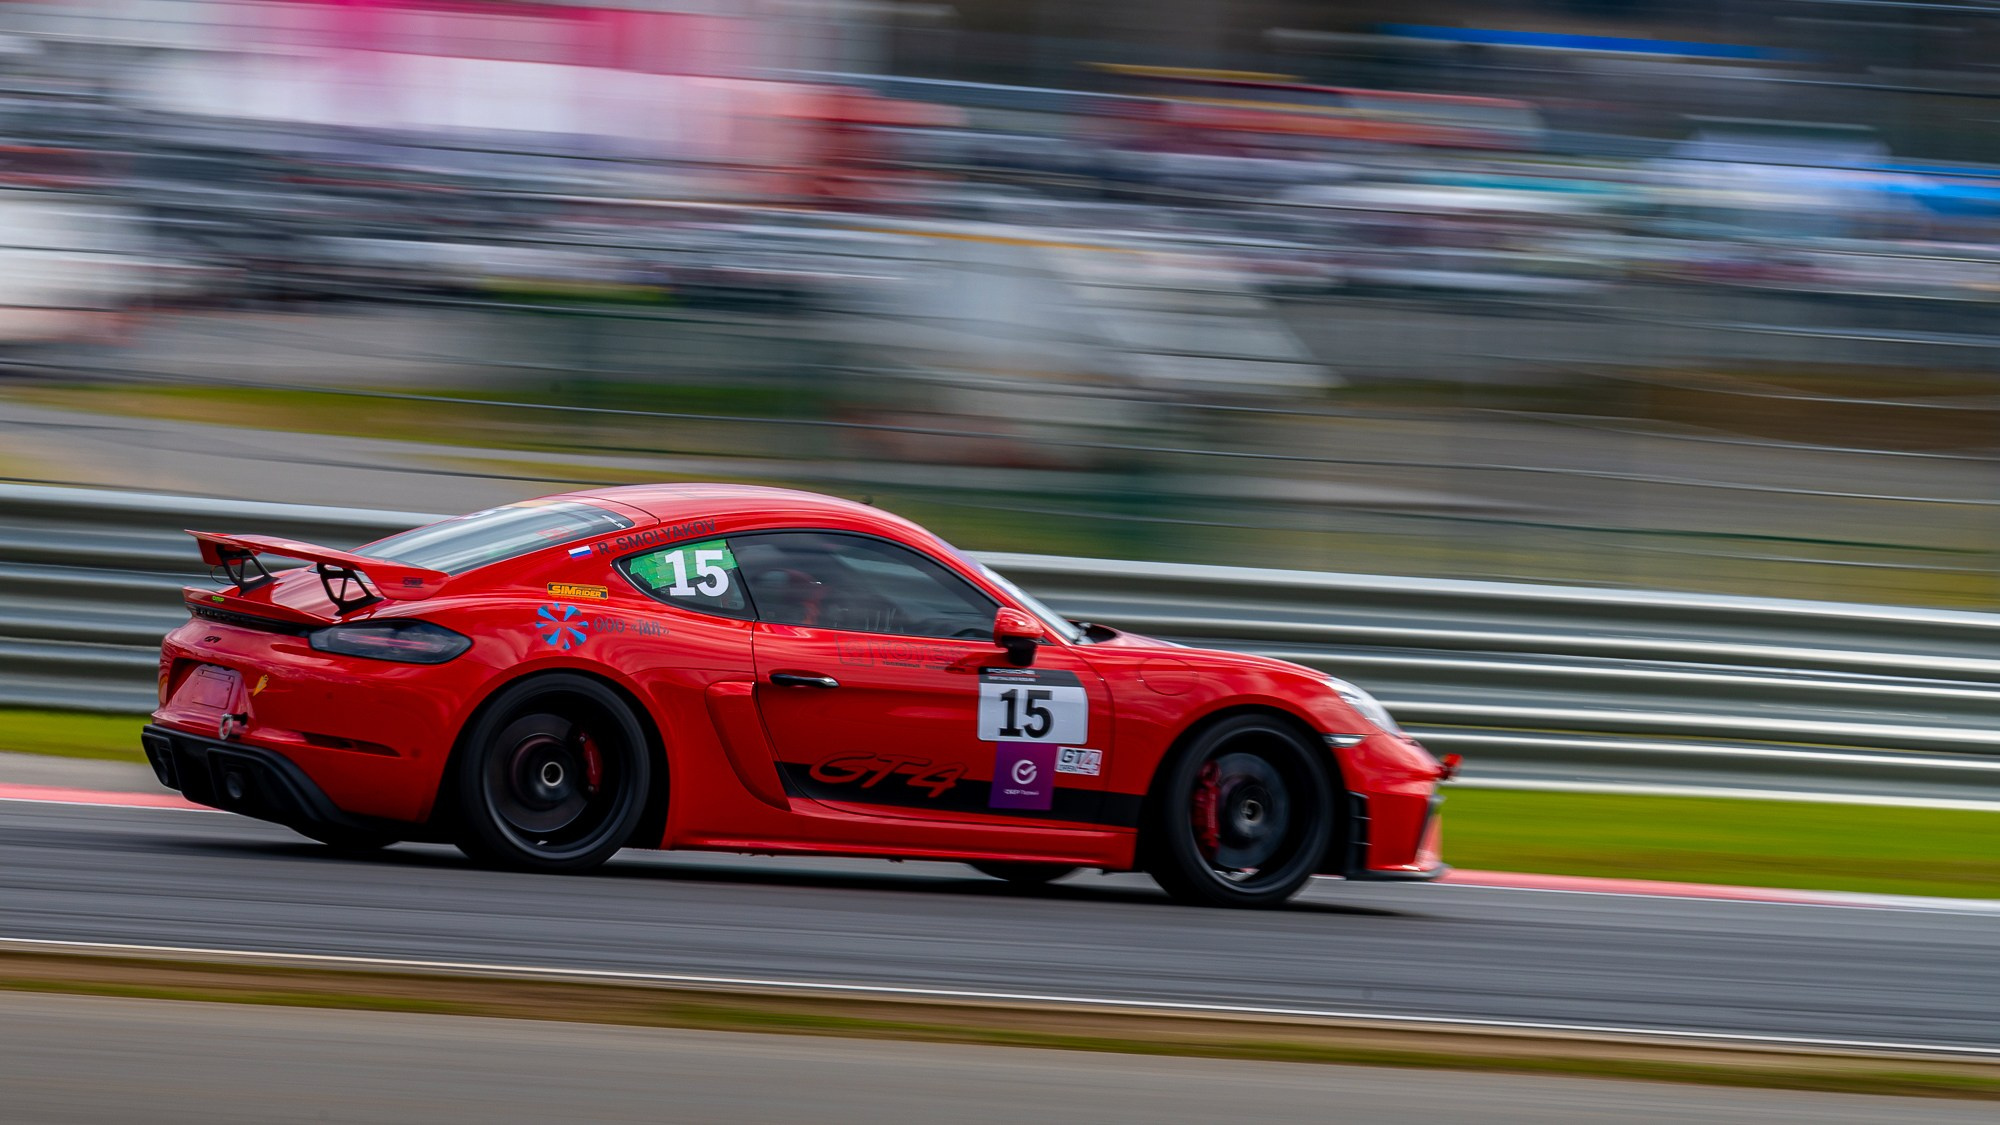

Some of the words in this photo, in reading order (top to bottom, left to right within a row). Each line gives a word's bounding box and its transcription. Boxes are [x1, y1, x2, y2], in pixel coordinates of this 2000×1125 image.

[597, 542, 616, 555] R.
[616, 518, 716, 551] SMOLYAKOV
[665, 549, 729, 597] 15
[998, 688, 1054, 738] 15
[809, 751, 968, 798] GT4
